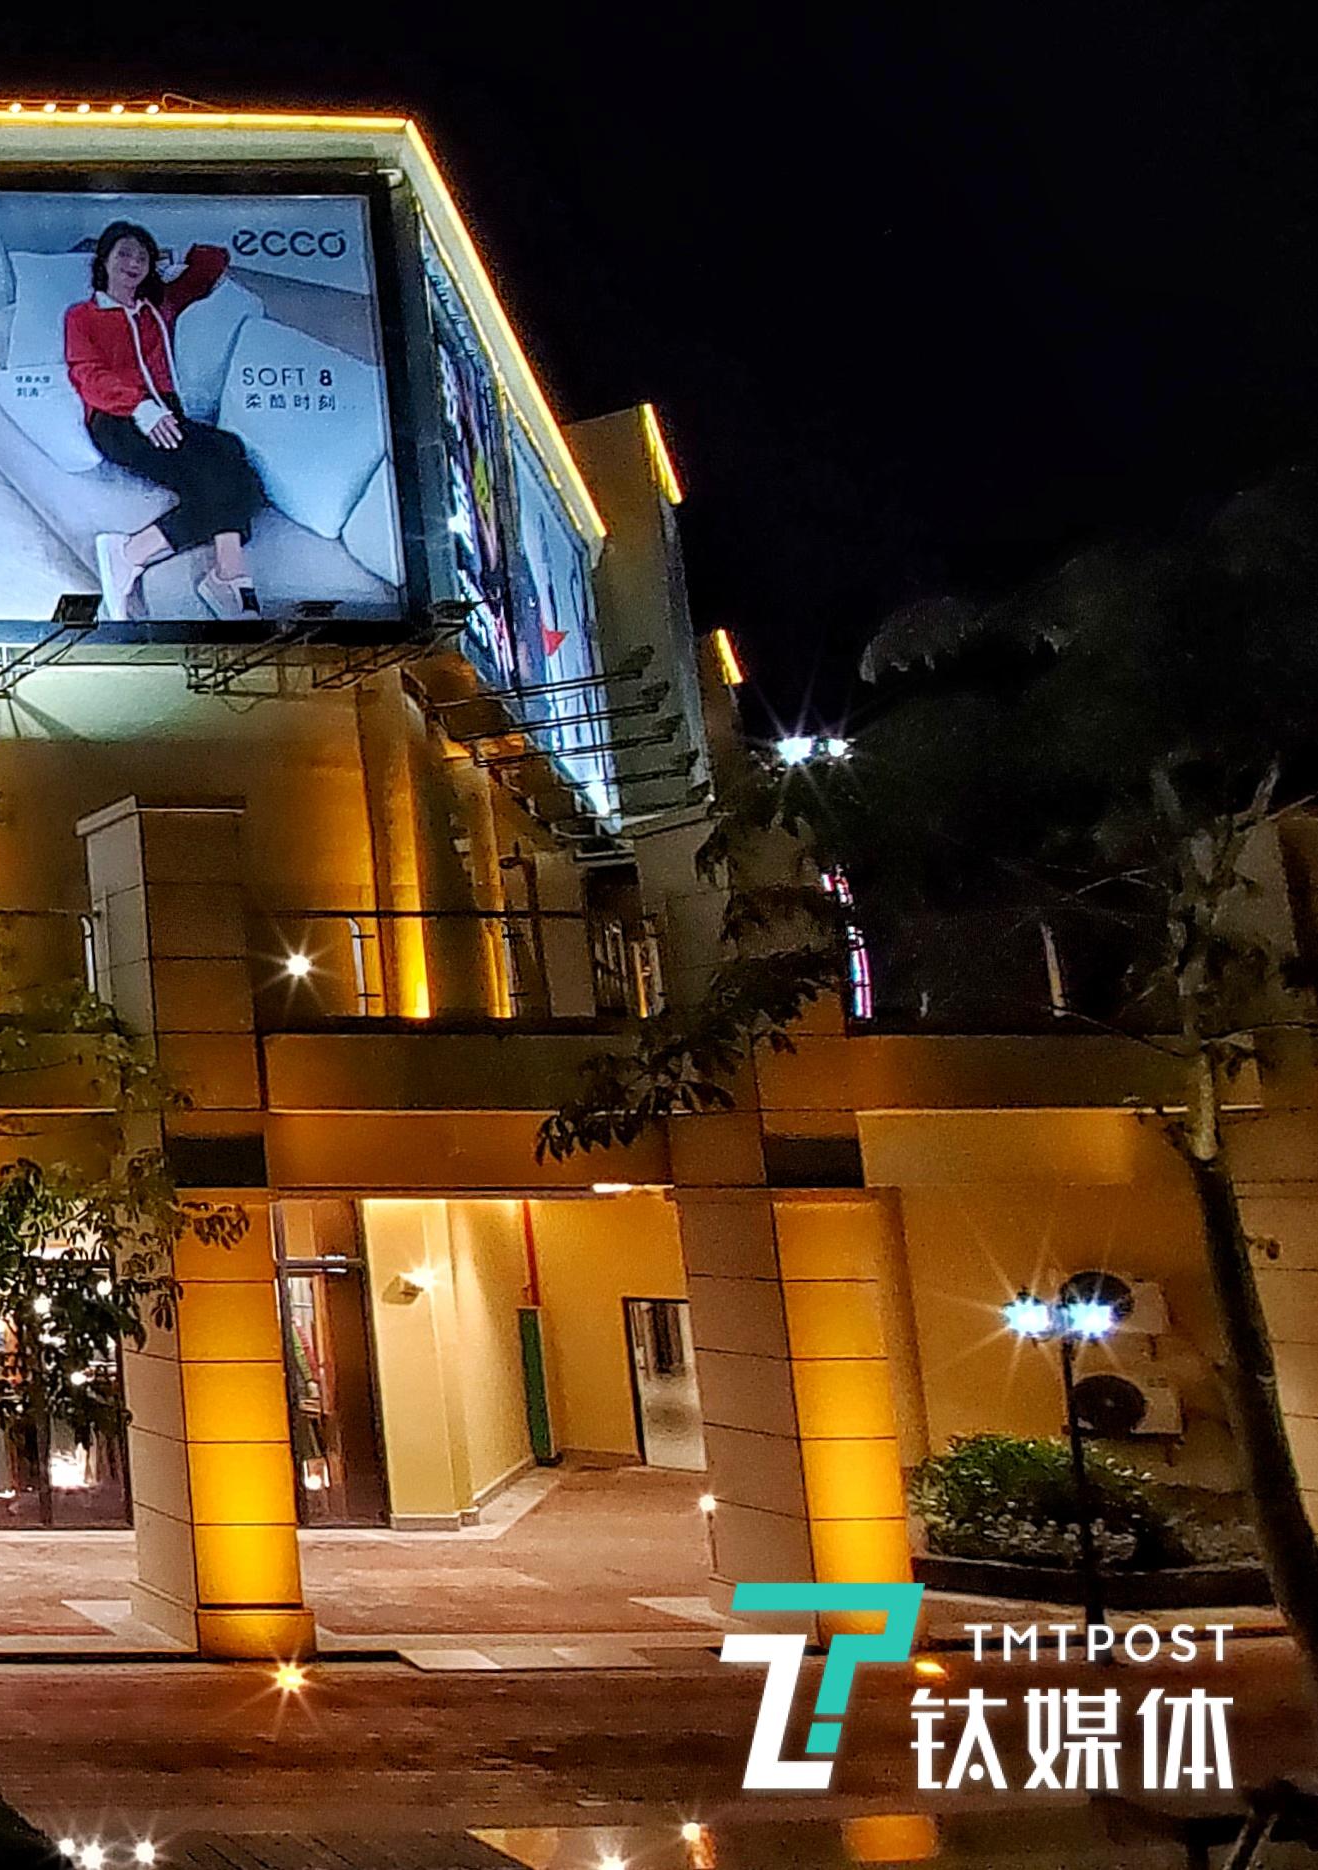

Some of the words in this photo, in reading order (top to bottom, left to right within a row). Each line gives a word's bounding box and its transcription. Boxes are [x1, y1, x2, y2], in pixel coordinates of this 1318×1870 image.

[232, 230, 346, 258] ecco
[242, 367, 305, 386] SOFT
[319, 369, 333, 386] 8
